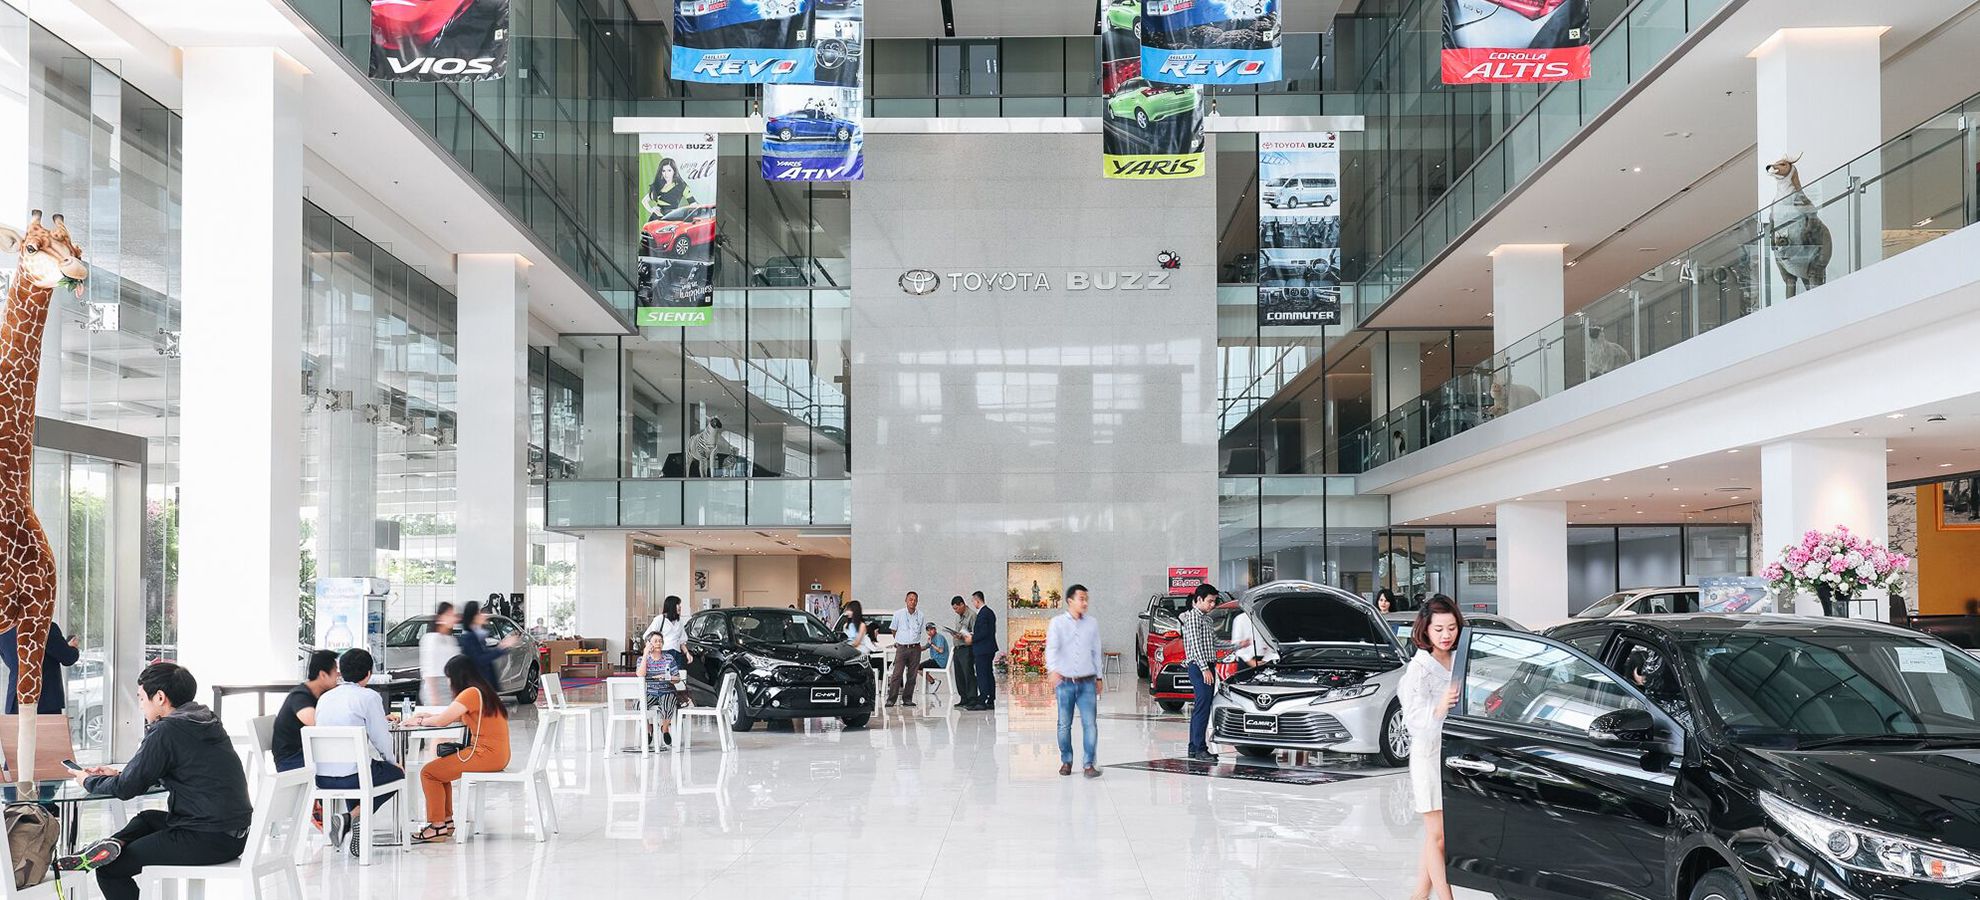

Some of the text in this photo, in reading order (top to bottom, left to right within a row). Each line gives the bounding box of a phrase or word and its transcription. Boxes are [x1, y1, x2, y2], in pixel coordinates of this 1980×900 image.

[1488, 52, 1547, 60] COROLLA
[386, 57, 496, 75] VIOS
[693, 58, 799, 77] REVO
[1160, 58, 1265, 78] REVO
[1463, 62, 1569, 79] ALTIS
[947, 271, 1172, 292] TOYOTA BUZZ
[646, 311, 706, 322] SIENTA
[1266, 311, 1335, 321] COMMUTER
[1246, 719, 1276, 727] CAMRY
